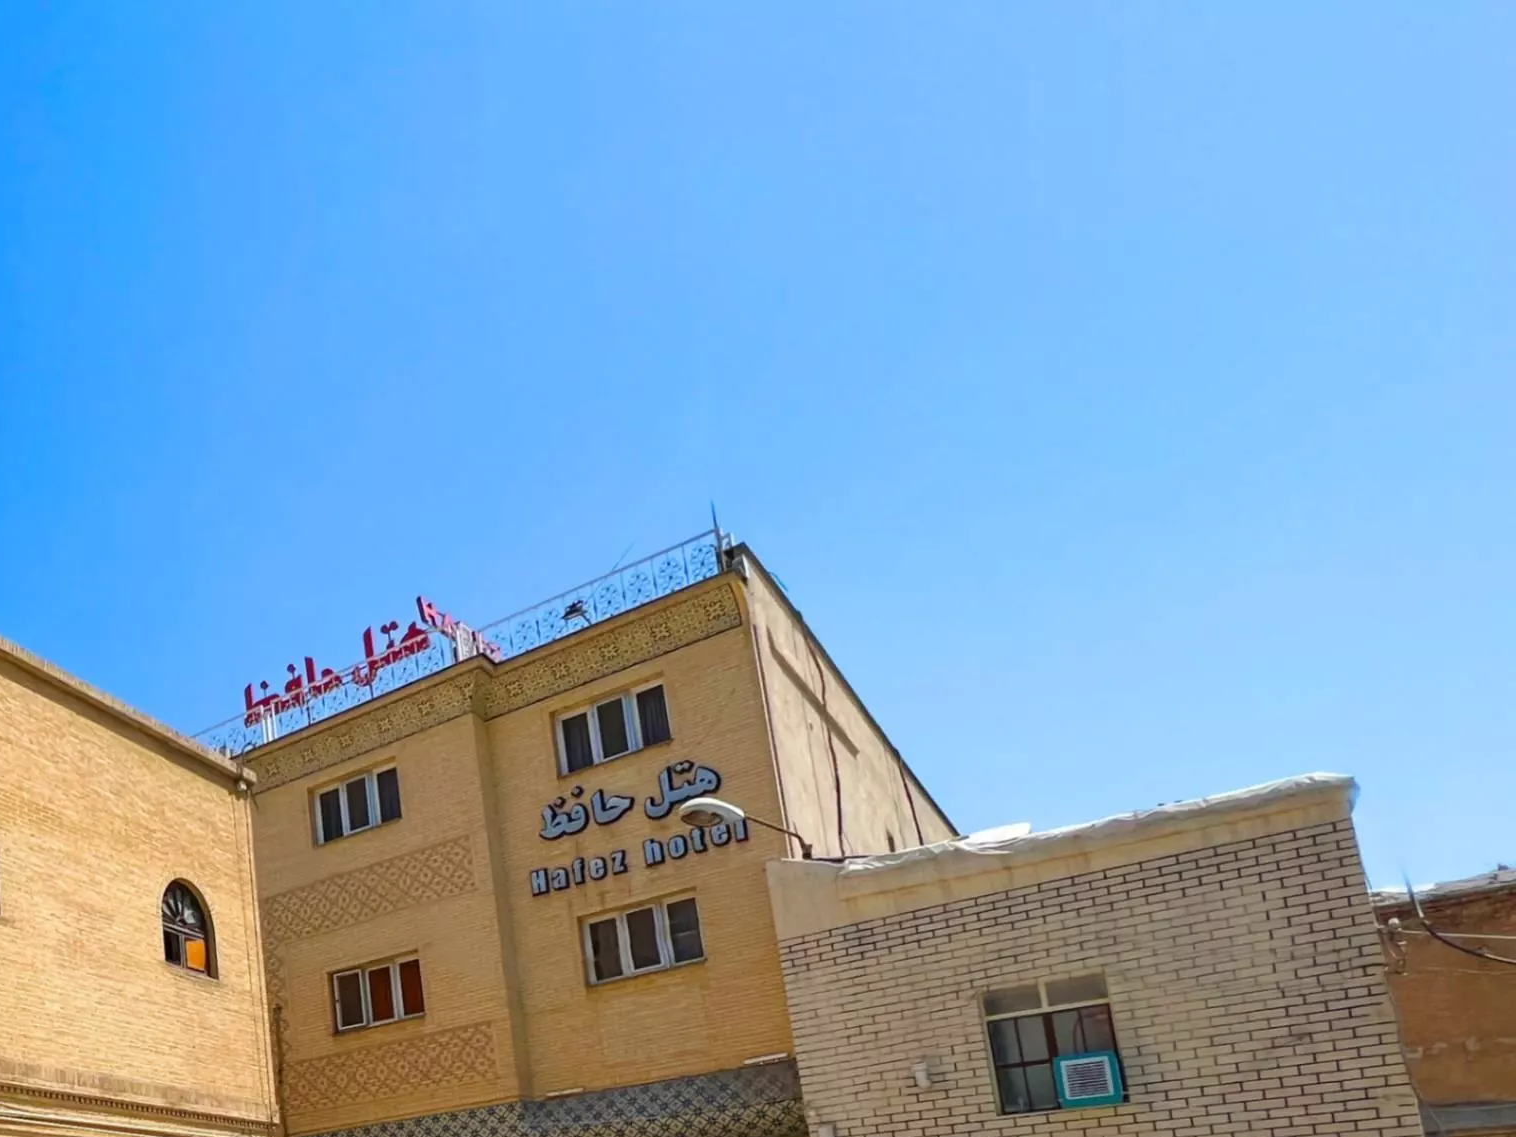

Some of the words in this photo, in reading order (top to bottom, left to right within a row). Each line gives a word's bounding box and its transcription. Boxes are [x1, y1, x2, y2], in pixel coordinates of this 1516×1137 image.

[352, 621, 430, 687] هتل
[539, 785, 635, 841] حافظ
[644, 760, 721, 820] هتل
[530, 849, 629, 897] Hafez
[643, 818, 749, 868] hotel
